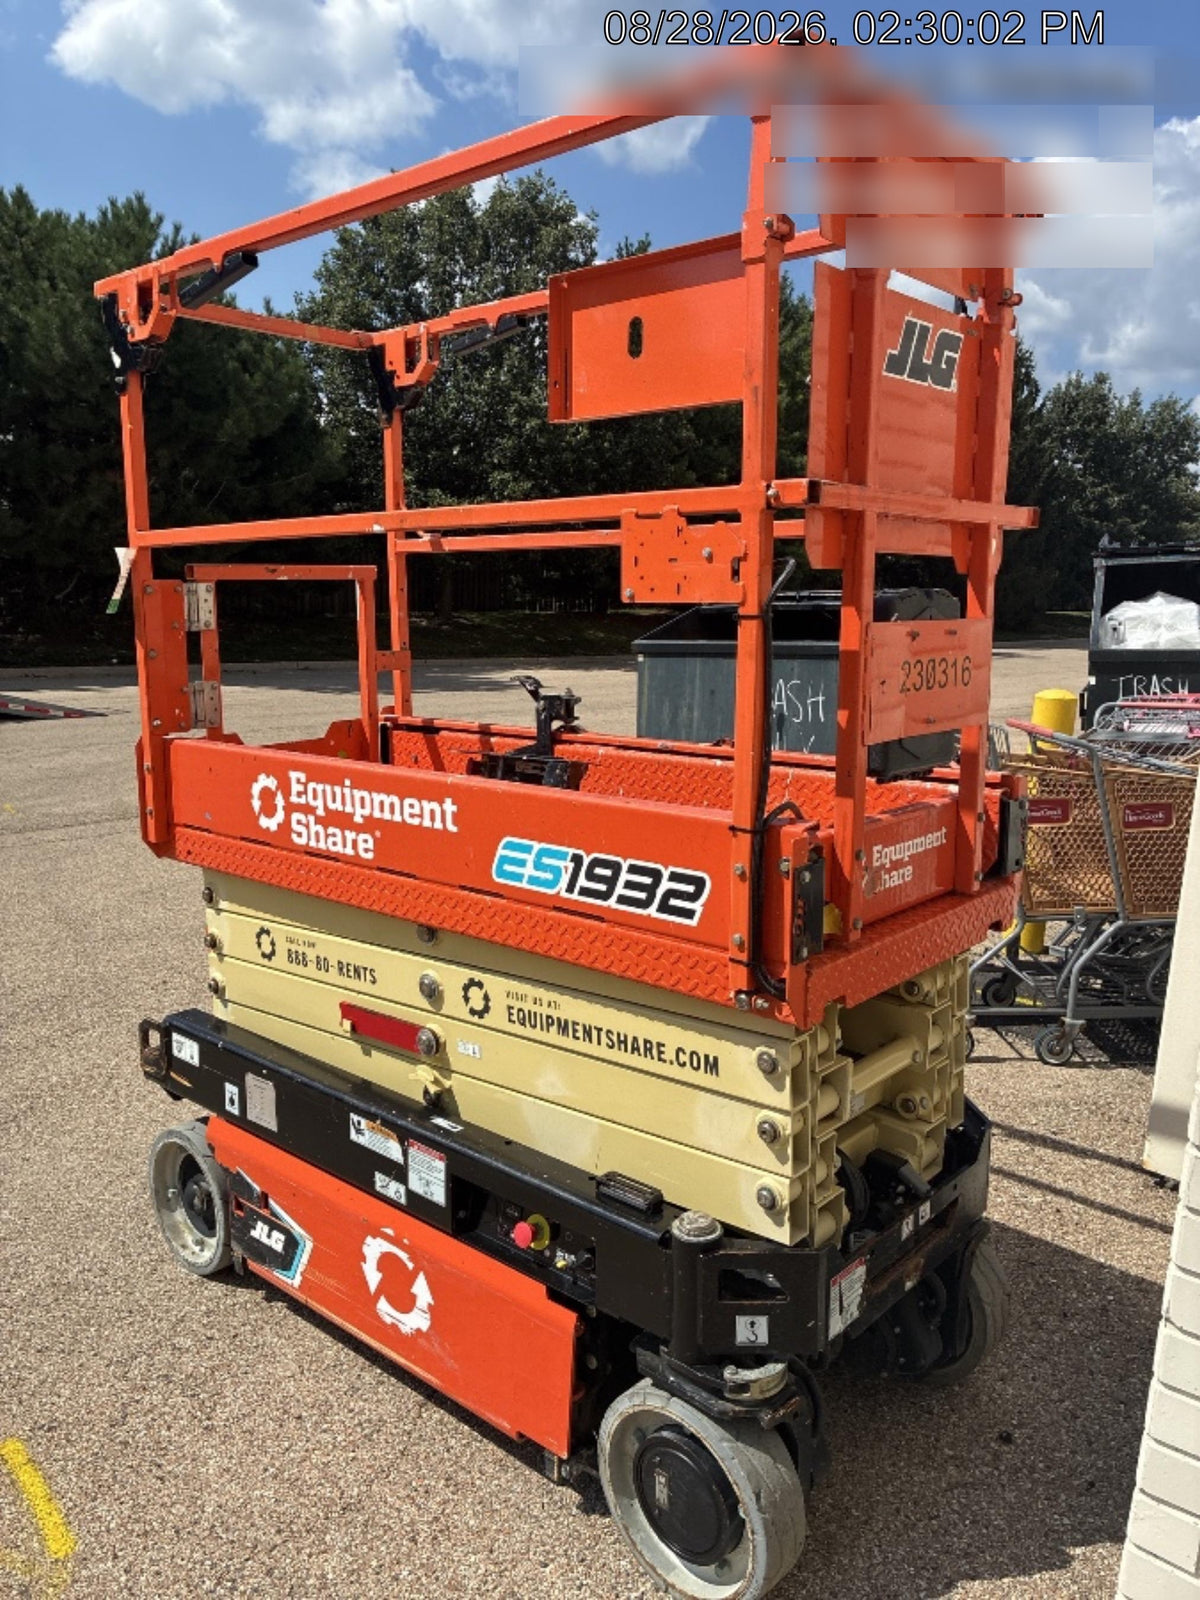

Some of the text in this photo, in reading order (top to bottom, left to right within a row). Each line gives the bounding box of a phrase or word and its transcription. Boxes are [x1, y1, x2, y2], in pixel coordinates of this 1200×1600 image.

[883, 316, 964, 391] JLG
[900, 656, 972, 693] 230316
[1112, 674, 1189, 699] TRASH
[771, 679, 826, 722] ASH
[288, 770, 458, 832] Equipment
[290, 812, 375, 859] Share
[873, 826, 947, 868] Equipment
[493, 837, 710, 925] ES1932
[874, 865, 913, 892] hare
[287, 948, 378, 985] 888-80-RENTS
[506, 1004, 720, 1077] EQUIPMENTSHARE.COM
[250, 1220, 286, 1252] JLG
